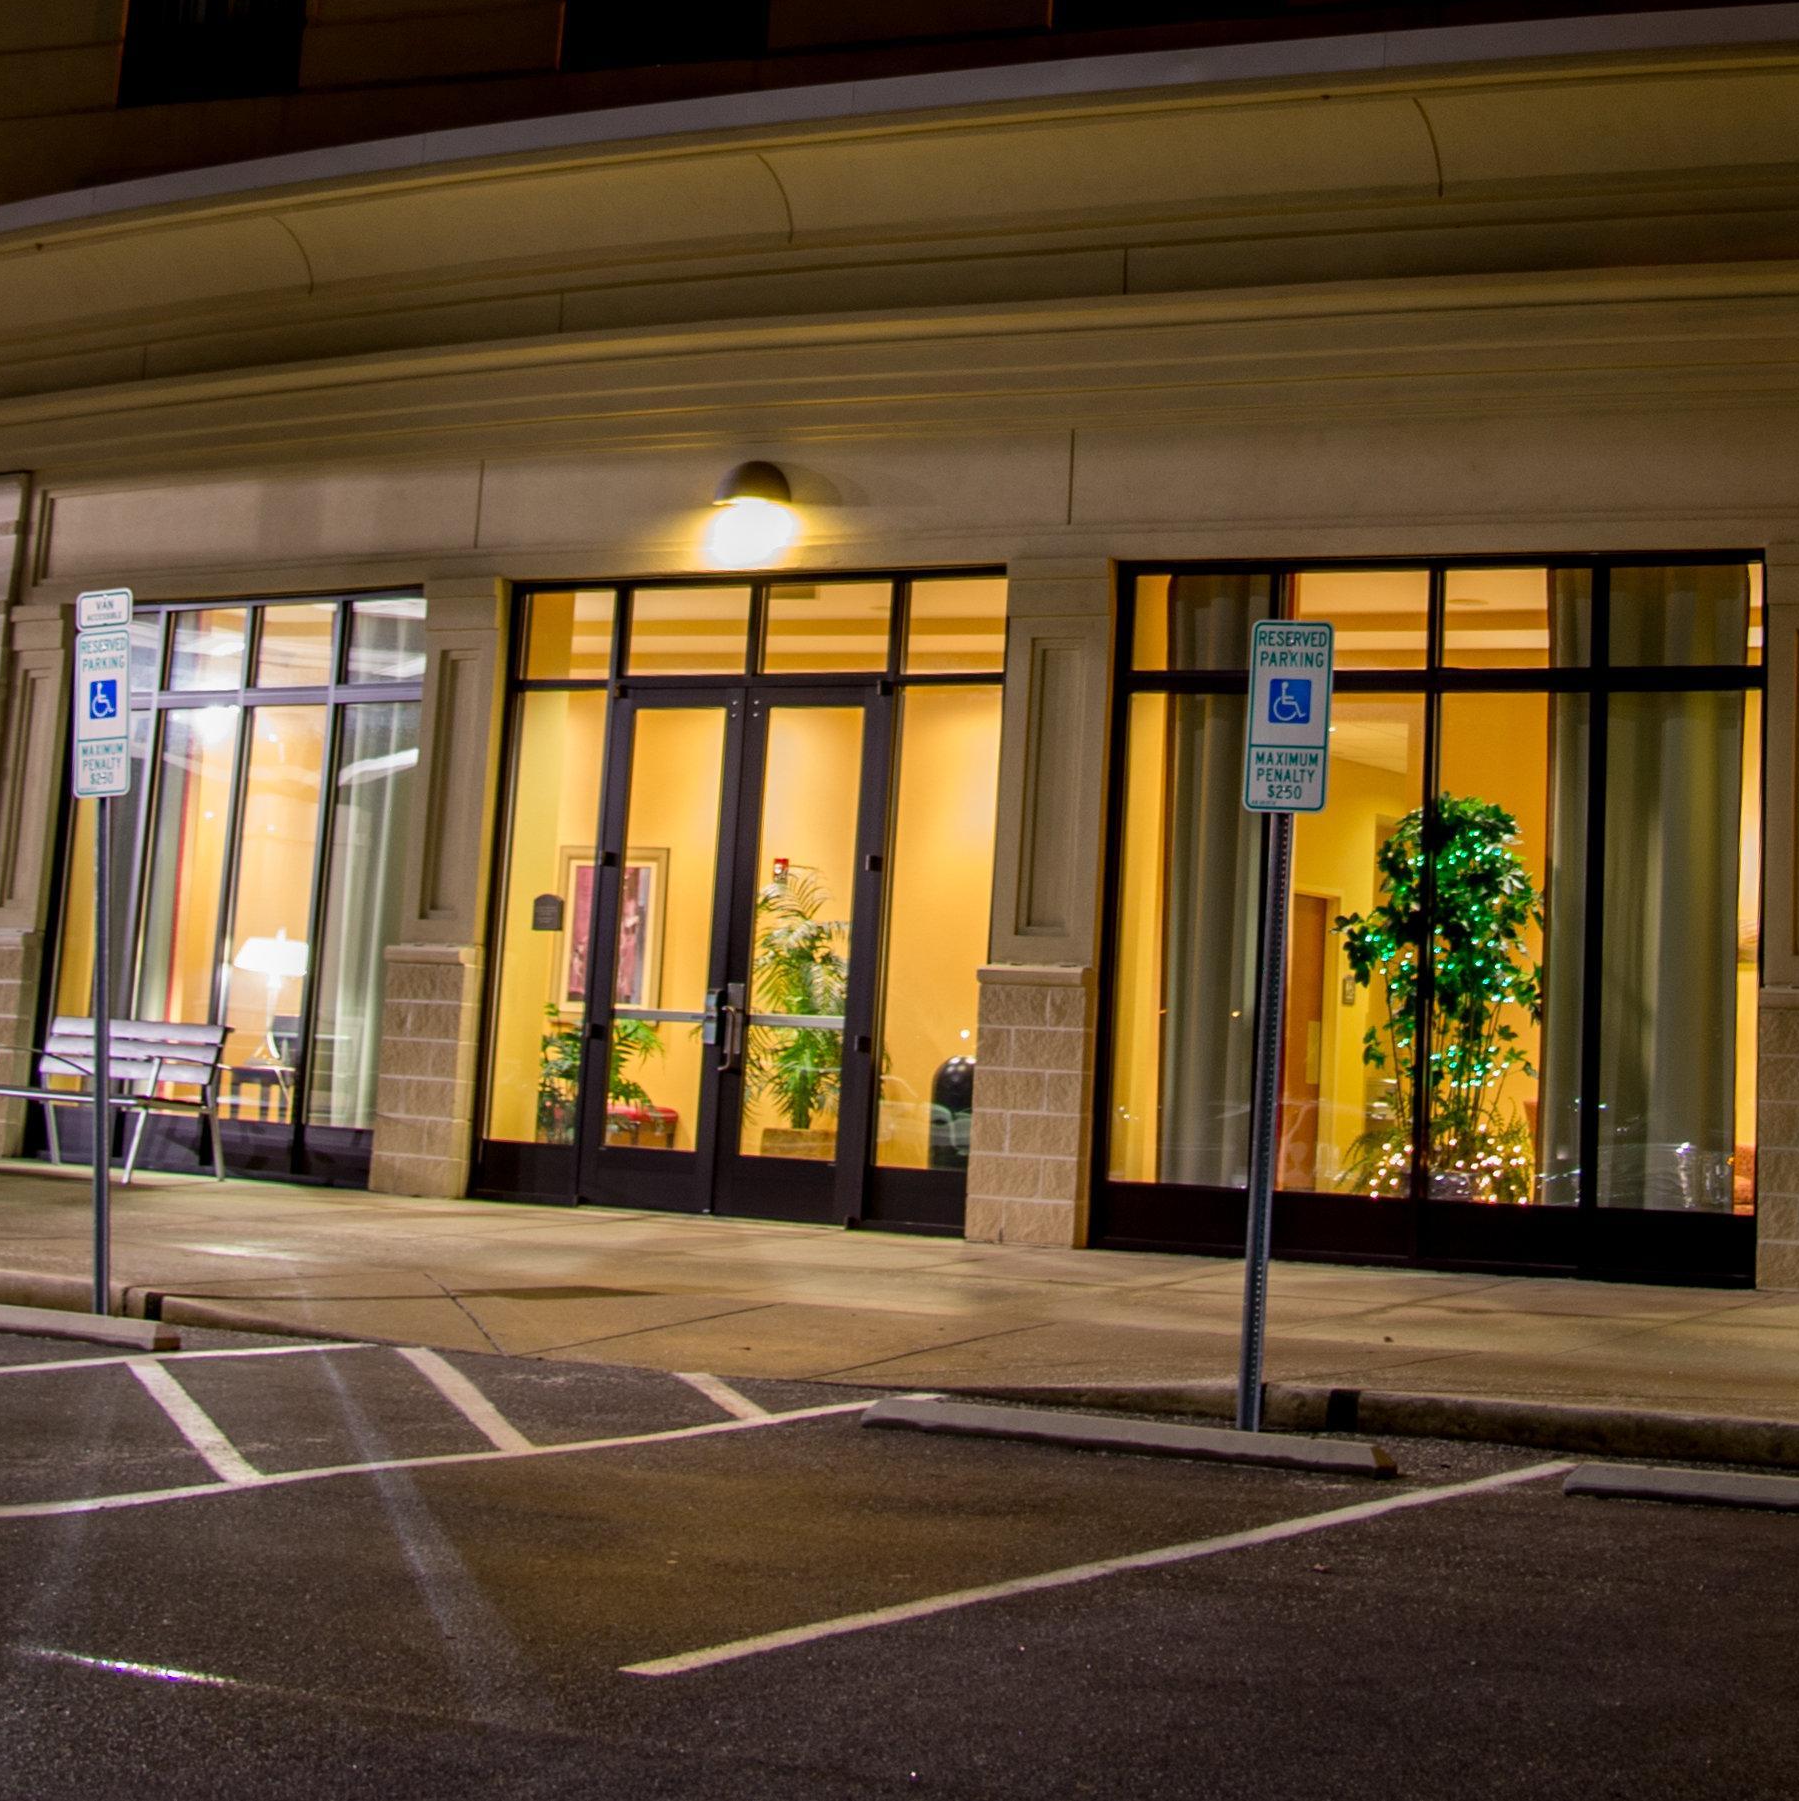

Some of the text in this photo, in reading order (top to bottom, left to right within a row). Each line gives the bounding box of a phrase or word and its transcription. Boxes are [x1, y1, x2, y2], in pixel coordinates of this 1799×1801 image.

[95, 600, 115, 611] VAN
[80, 637, 127, 654] RESERVED
[1257, 630, 1328, 648] RESERVED
[82, 654, 126, 673] PARKING
[1260, 651, 1325, 668] PARKING
[81, 743, 124, 758] MAXIMUM
[82, 756, 122, 773] PENALTY
[1255, 751, 1319, 768] MAXIMUM
[1256, 767, 1316, 784] PENALTY
[1267, 784, 1303, 800] $250
